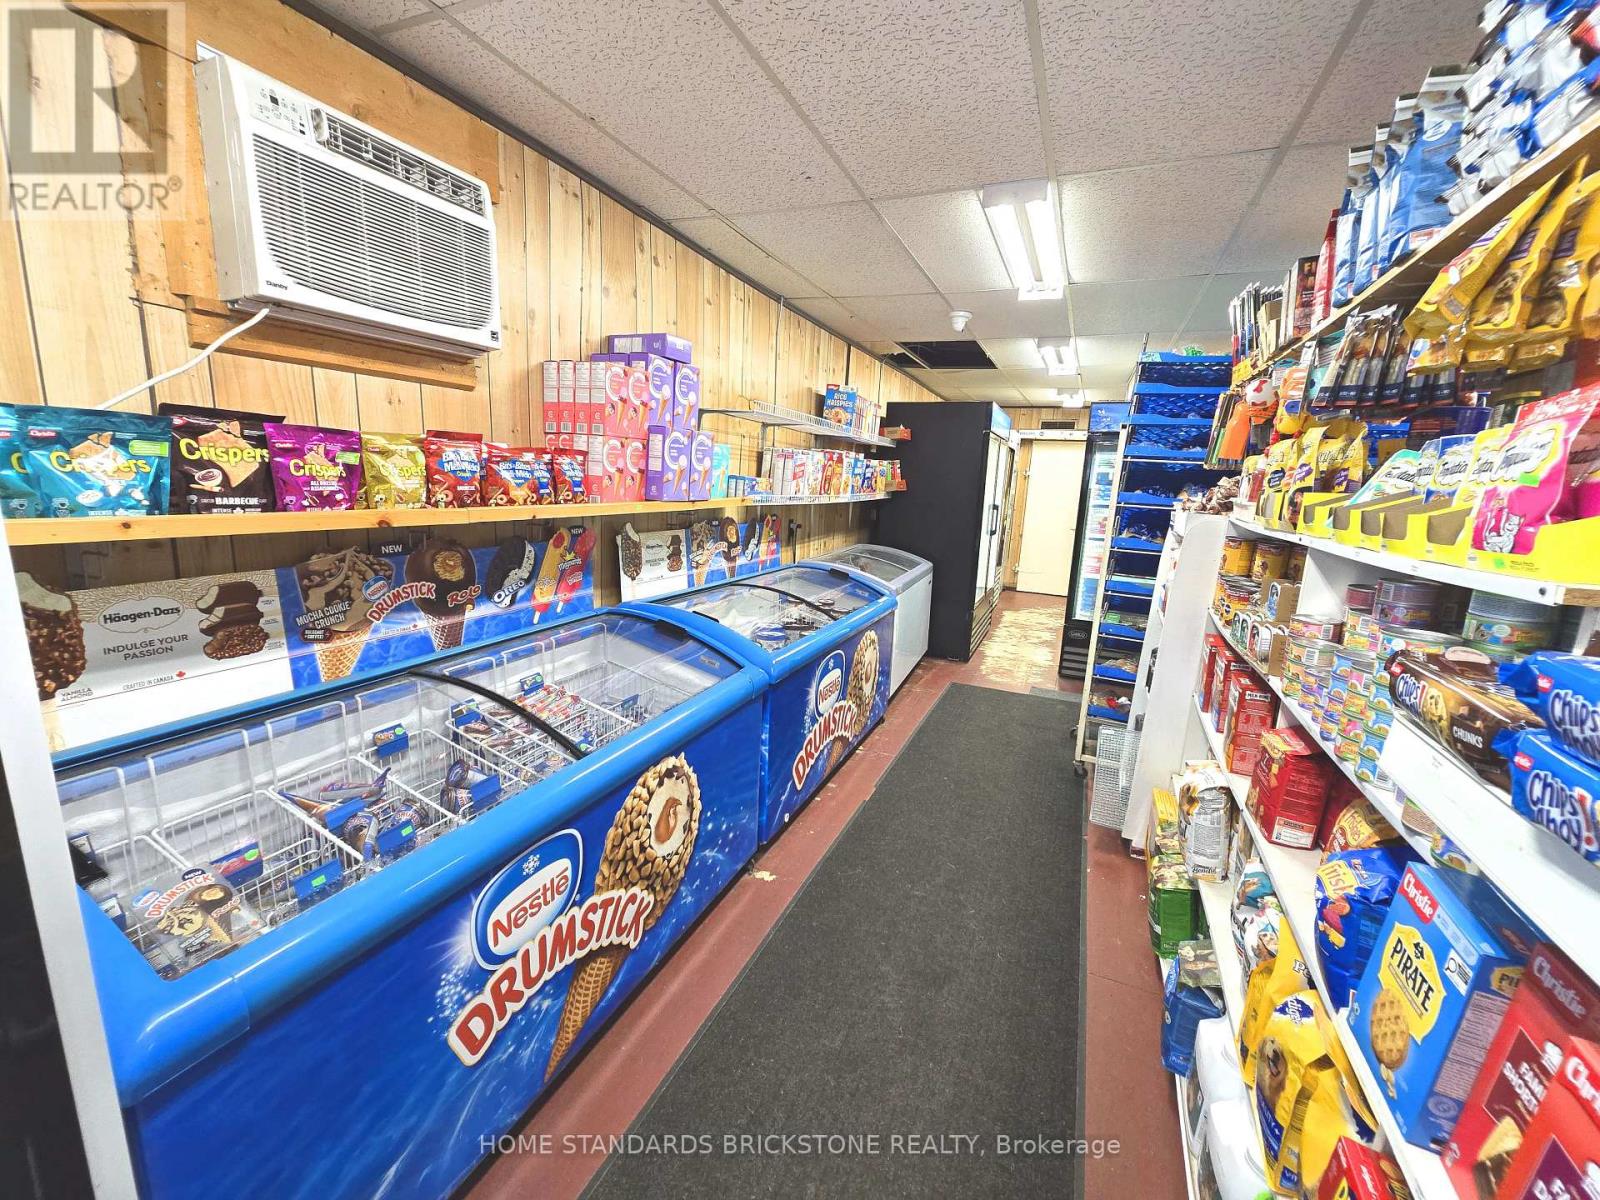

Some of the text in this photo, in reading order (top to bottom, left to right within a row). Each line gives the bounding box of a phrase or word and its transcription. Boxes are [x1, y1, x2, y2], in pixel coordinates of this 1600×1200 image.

[381, 544, 403, 554] NEW
[367, 582, 436, 621] DRUMSTICK
[493, 580, 525, 604] OREO
[103, 606, 180, 624] Häagen-Dazs
[296, 609, 324, 626] MOCHA
[323, 601, 351, 616] COOKIE
[314, 614, 345, 629] CRUNCH
[103, 634, 189, 655] INDULGE YOUR
[123, 646, 174, 661] PASSION
[794, 703, 857, 786] DRUMSTICK
[1452, 725, 1483, 749] CHUNKS
[1528, 771, 1579, 817] Chips
[146, 873, 213, 917] DRUMSTICK
[491, 867, 569, 947] Nestlé
[1403, 872, 1434, 919] Christie
[454, 892, 651, 1057] DRUMSTICK
[1390, 937, 1435, 1012] PIRATE
[1533, 956, 1586, 1019] Christie
